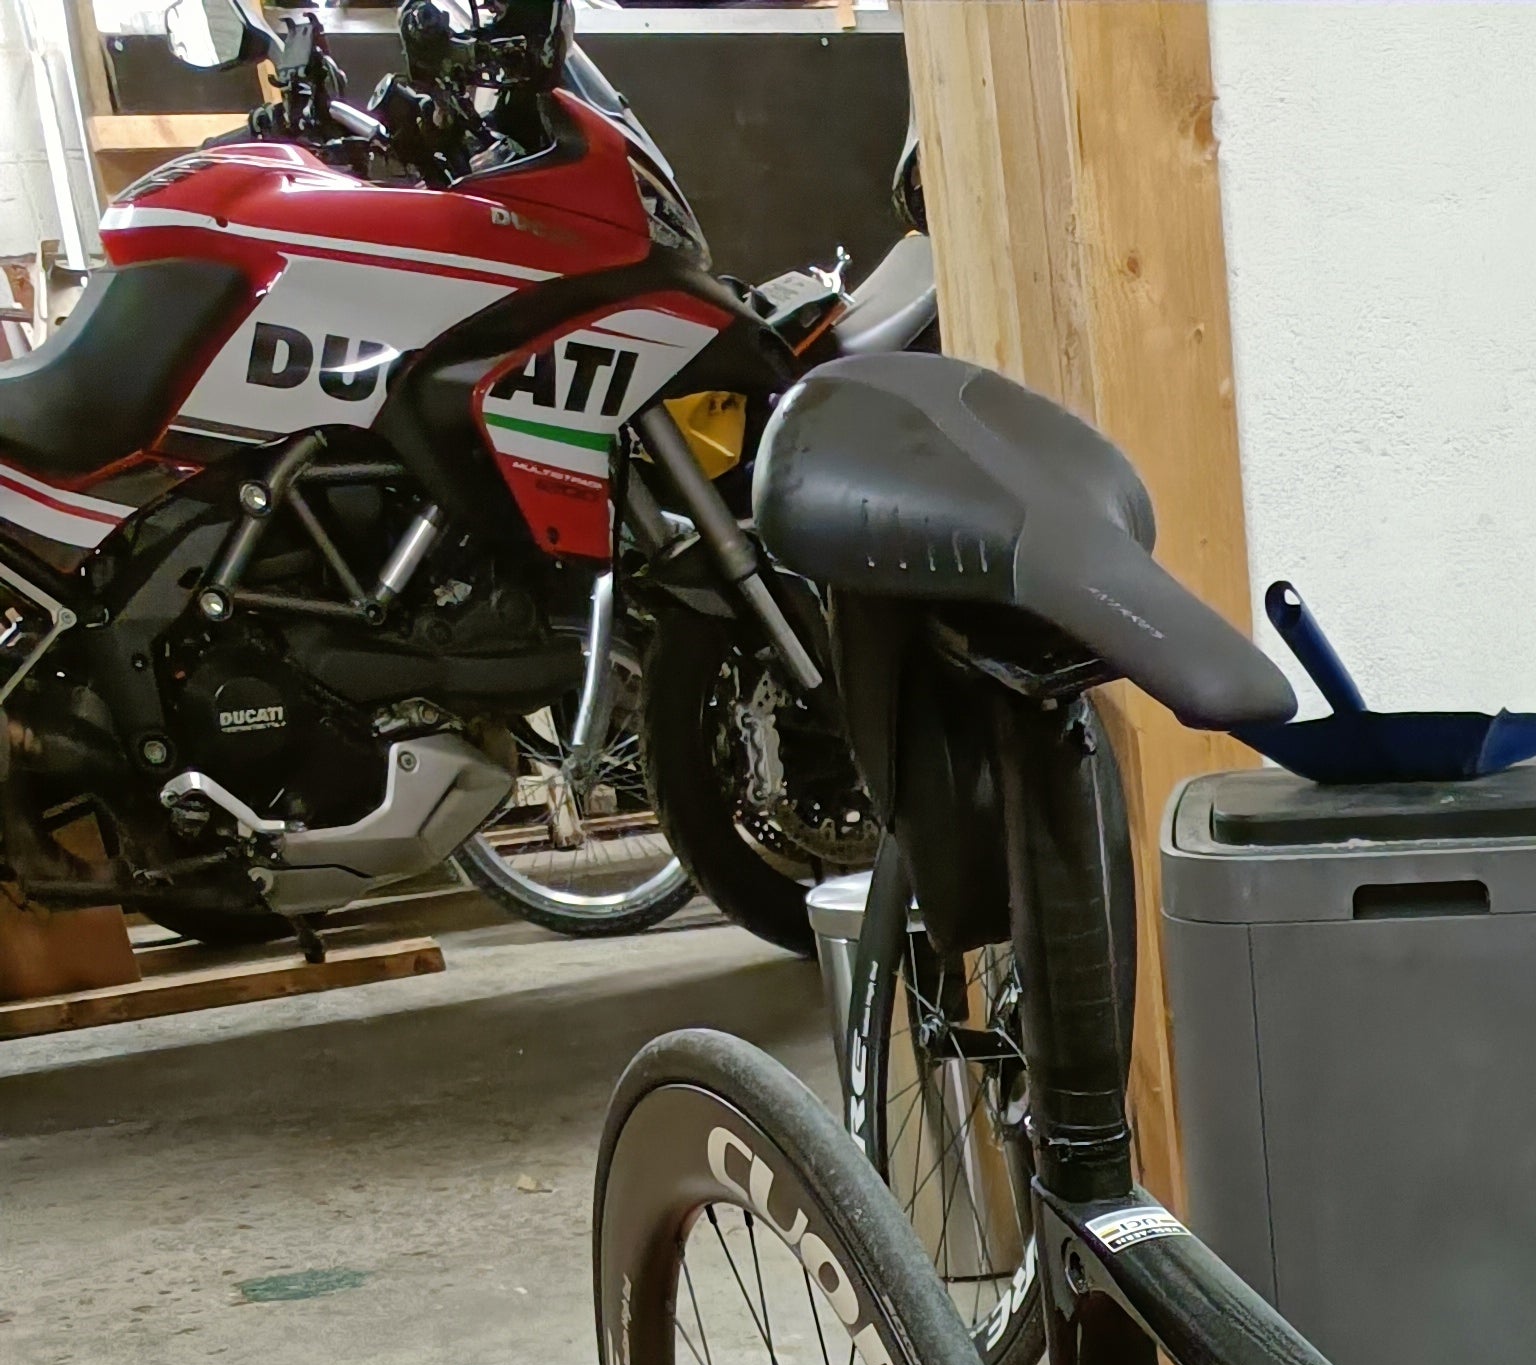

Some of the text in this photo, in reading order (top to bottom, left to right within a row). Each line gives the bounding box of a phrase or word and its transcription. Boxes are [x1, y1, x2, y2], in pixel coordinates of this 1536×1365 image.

[246, 321, 640, 417] DUATI
[219, 706, 284, 727] DUCATI
[1119, 1217, 1159, 1231] UCI
